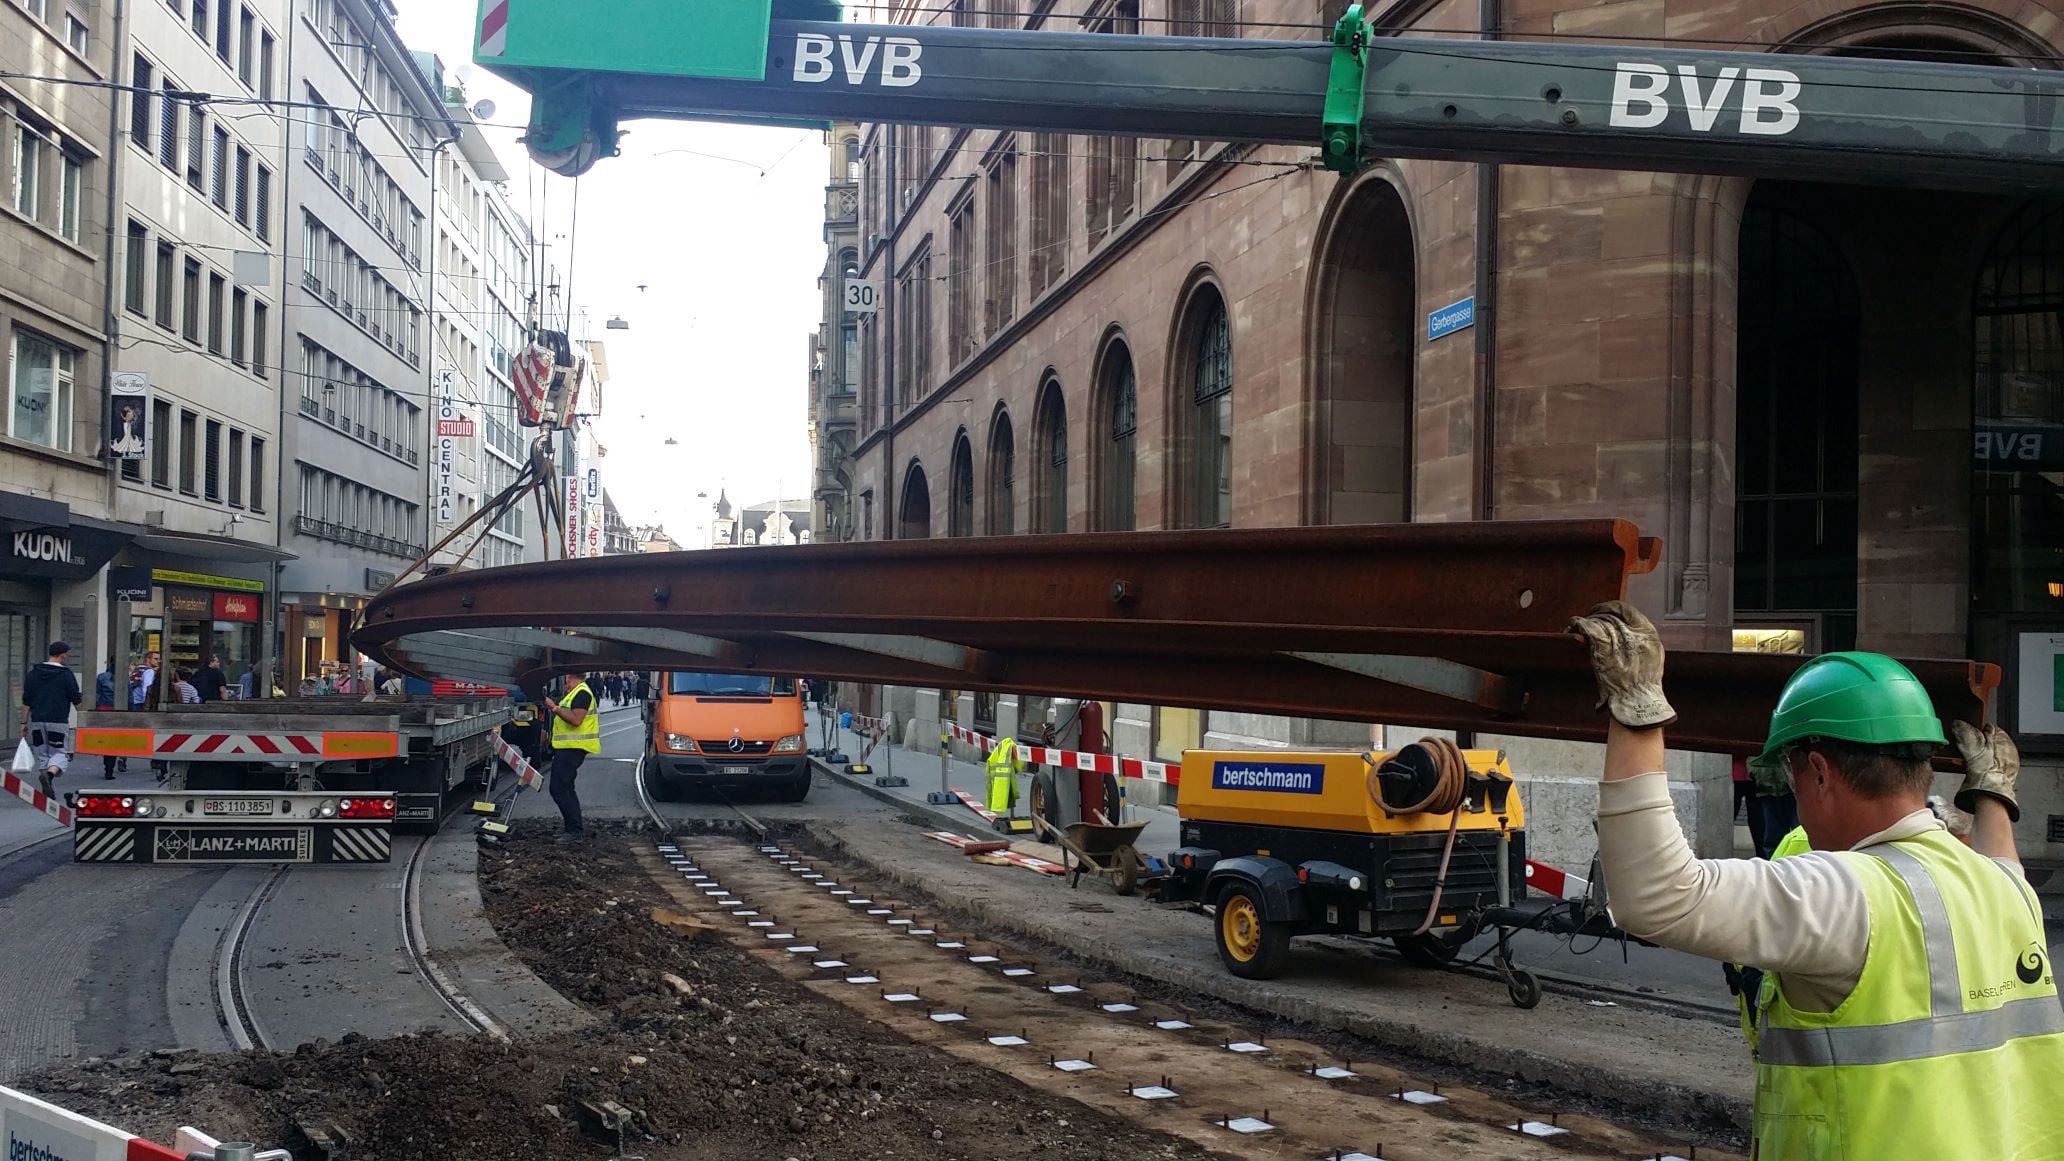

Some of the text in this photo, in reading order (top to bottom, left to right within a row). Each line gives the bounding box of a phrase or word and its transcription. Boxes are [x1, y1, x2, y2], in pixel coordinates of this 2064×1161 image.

[792, 32, 923, 88] BVB
[1609, 62, 1801, 136] BVB
[849, 285, 872, 305] 30
[1431, 307, 1471, 332] Gerbergasse
[441, 372, 452, 418] KINO
[440, 422, 472, 435] STUDIO
[441, 438, 451, 520] CENTRAL
[569, 478, 578, 511] SHOES
[14, 532, 71, 563] KUONI
[588, 526, 599, 546] city
[1222, 766, 1312, 789] bertschmann
[397, 809, 429, 817] ANZ+MARTI
[191, 837, 296, 851] LANZ+MARTI
